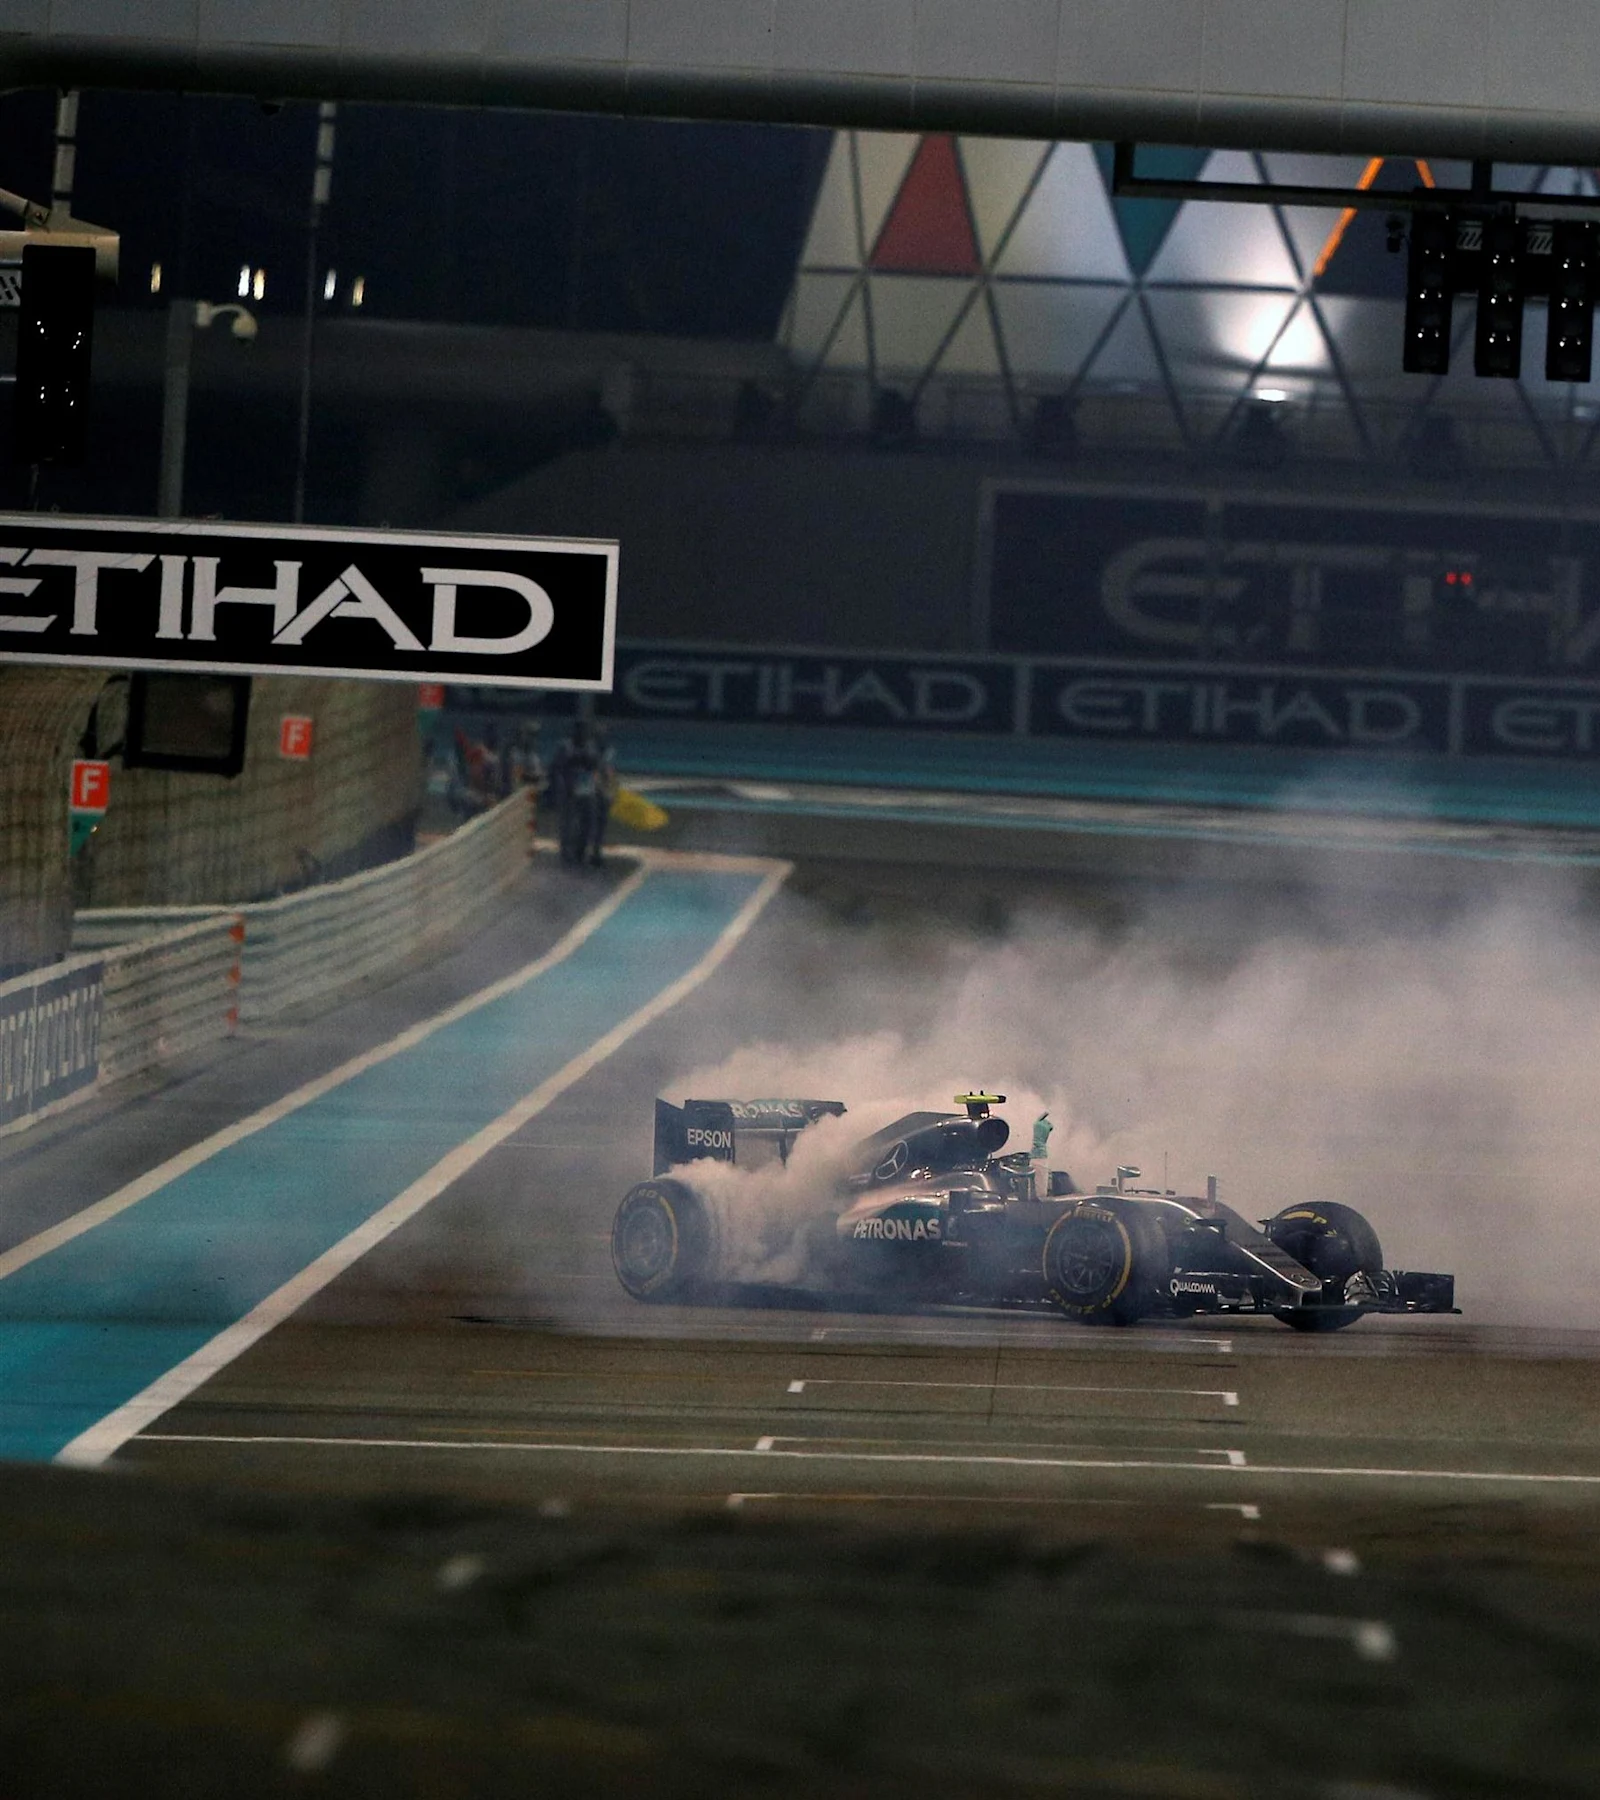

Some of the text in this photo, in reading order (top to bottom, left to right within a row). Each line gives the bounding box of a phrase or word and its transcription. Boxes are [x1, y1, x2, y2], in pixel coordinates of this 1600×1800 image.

[623, 660, 982, 721] ETIHAD
[1061, 680, 1420, 742] ETIHAD
[80, 768, 103, 803] F
[687, 1127, 732, 1149] EPSON
[853, 1217, 943, 1241] PETRONAS
